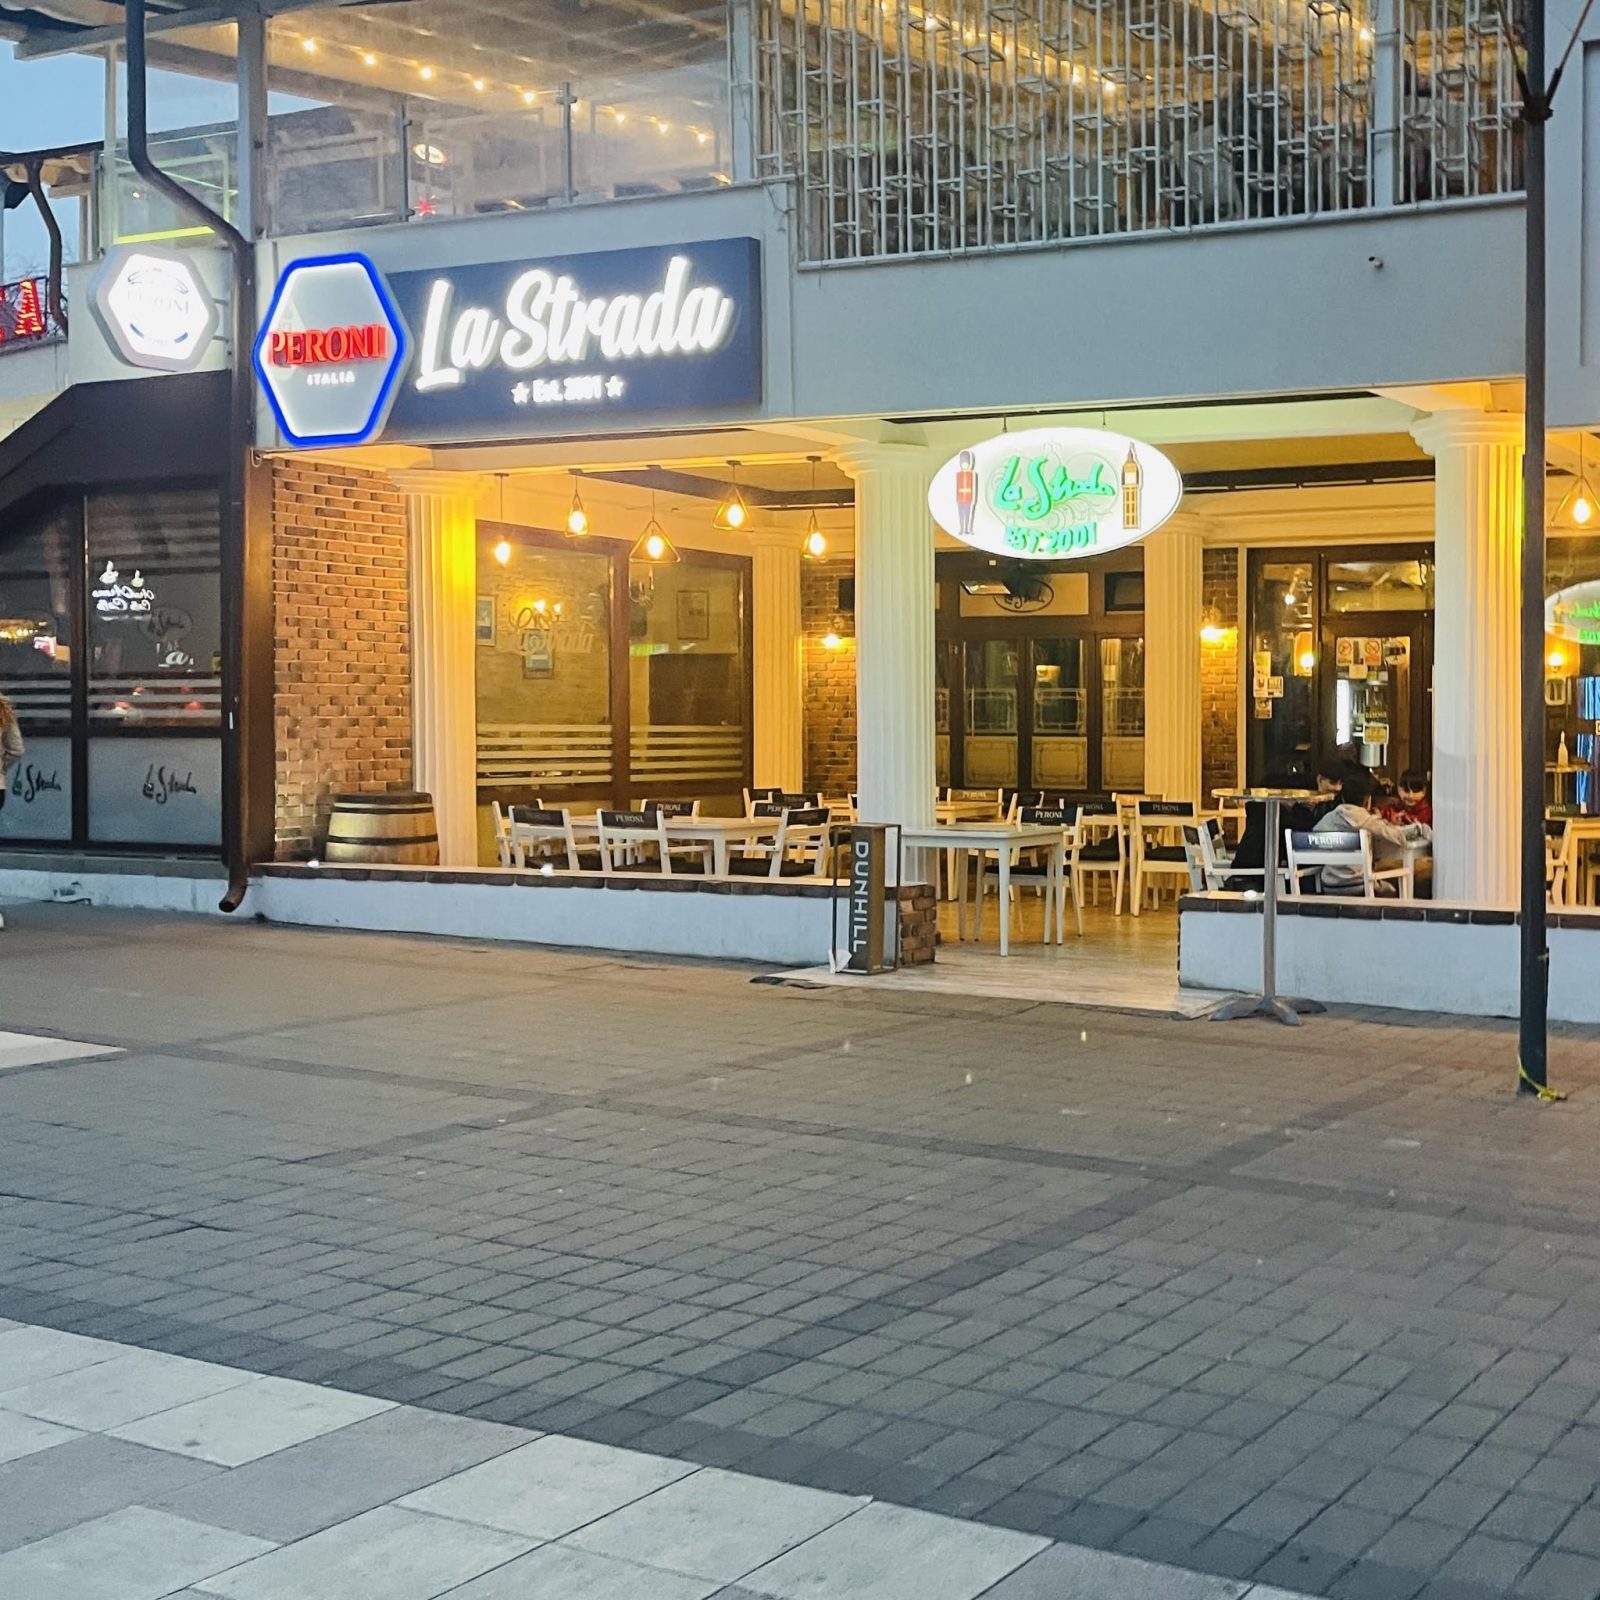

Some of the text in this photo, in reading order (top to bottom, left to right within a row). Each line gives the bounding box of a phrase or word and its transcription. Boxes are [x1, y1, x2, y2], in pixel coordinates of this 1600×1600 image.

[415, 255, 736, 391] La Strada
[269, 324, 388, 367] PERONI
[306, 371, 355, 386] ITALIA
[1034, 810, 1064, 819] PERONI
[853, 841, 869, 953] DUNHILL
